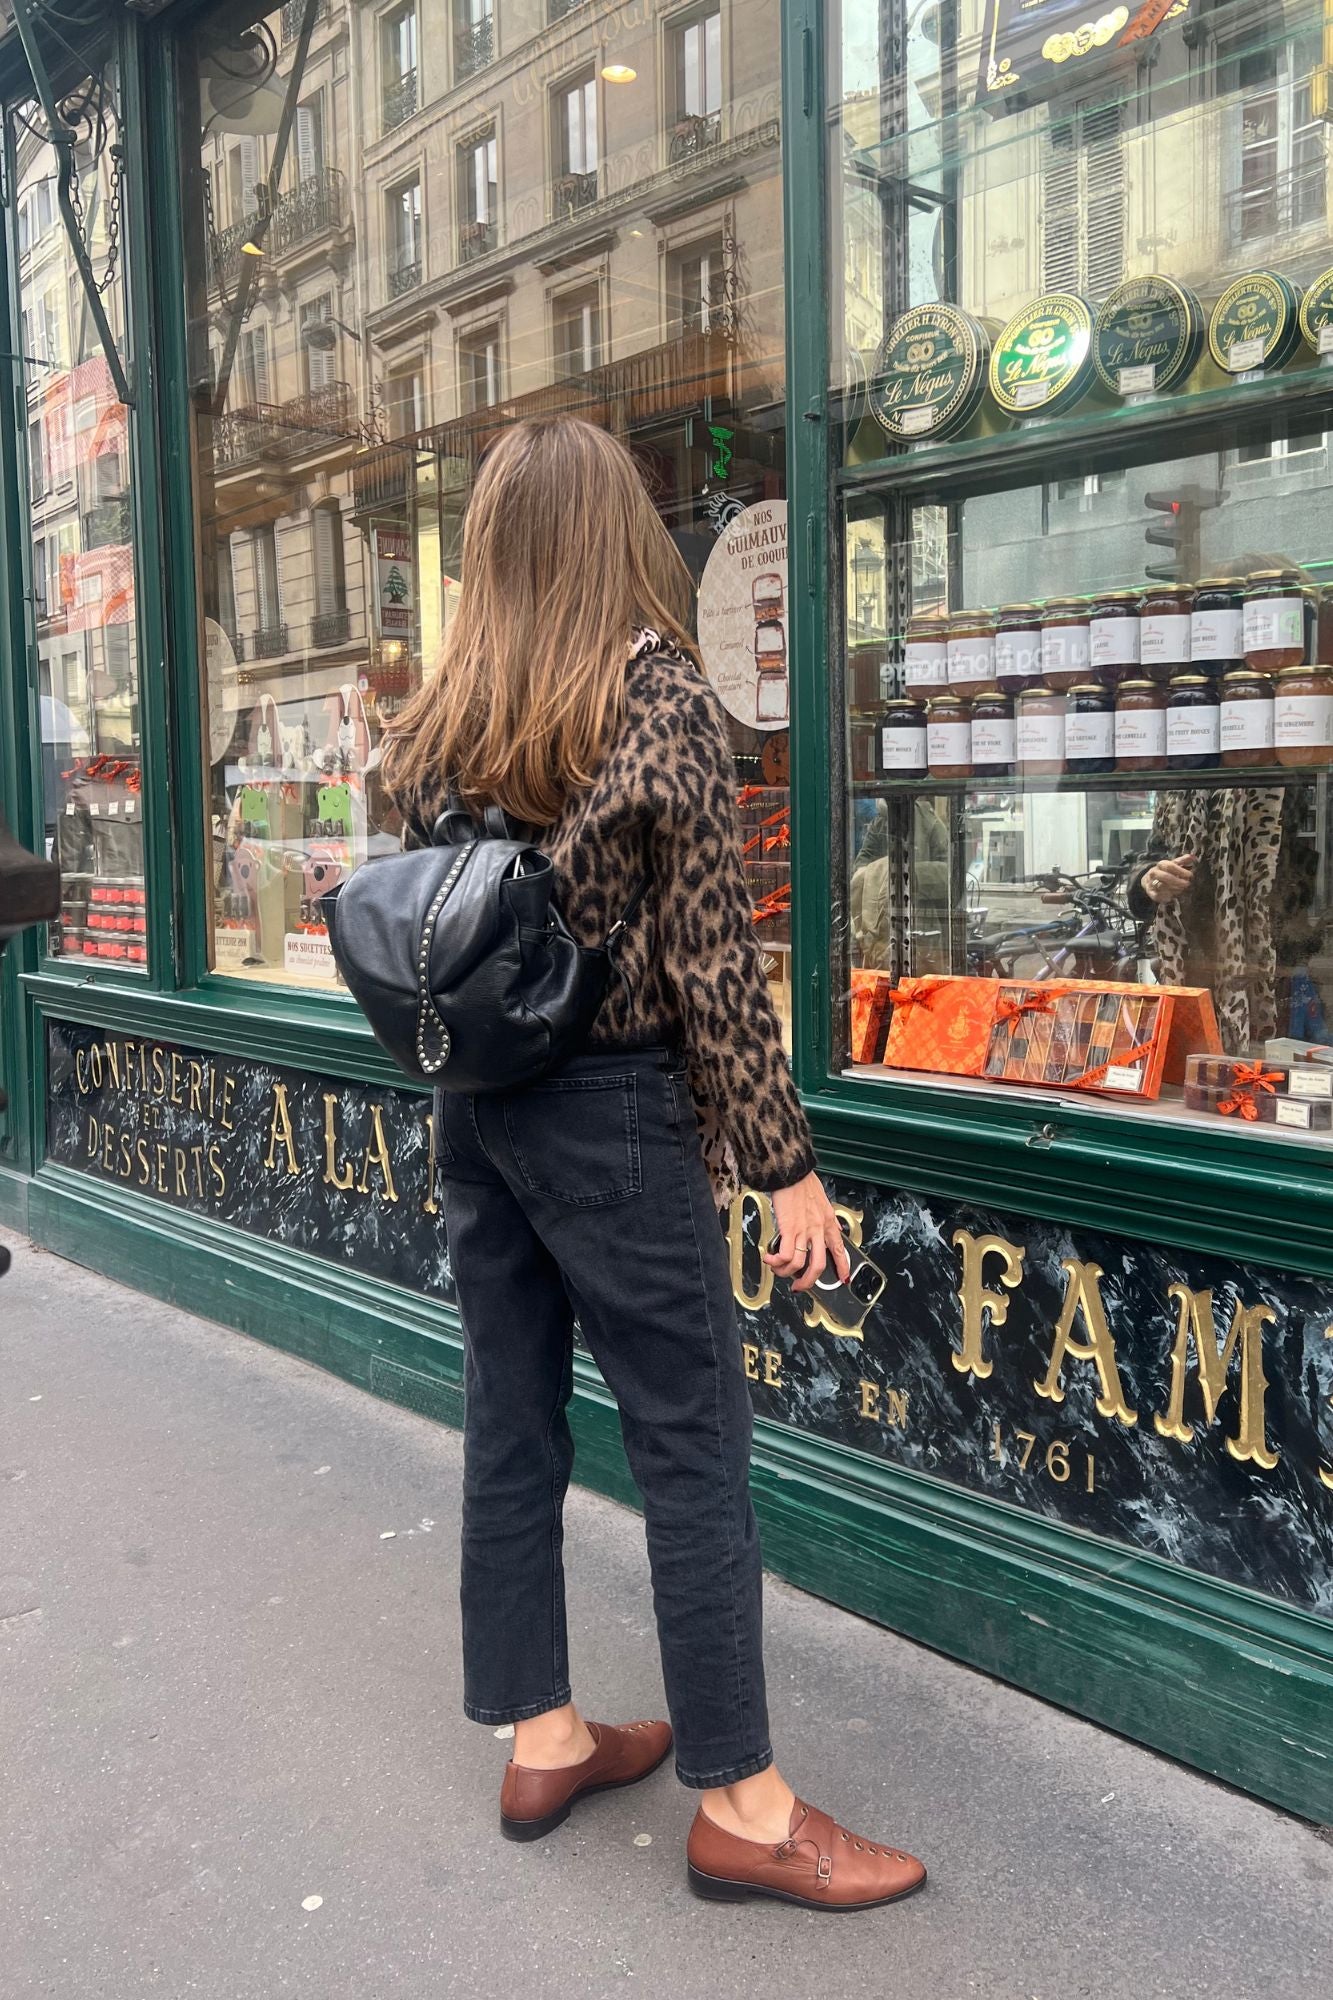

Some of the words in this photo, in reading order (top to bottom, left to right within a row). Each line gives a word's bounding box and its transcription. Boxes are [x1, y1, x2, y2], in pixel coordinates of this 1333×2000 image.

[1106, 342, 1124, 367] Le
[883, 378, 904, 408] Le
[903, 369, 955, 404] Négus
[753, 509, 773, 526] NOS
[727, 522, 788, 556] GUIMAUV
[741, 555, 754, 570] DE
[287, 941, 299, 952] NOS
[300, 942, 333, 955] SUCETTES
[76, 1042, 235, 1130] CONFISERIE
[143, 1103, 161, 1130] ET
[87, 1115, 226, 1198] DESSERTS
[263, 1083, 301, 1175] A
[322, 1093, 399, 1202] LA
[951, 1229, 1333, 1490] FAM
[858, 1379, 909, 1429] EN
[990, 1423, 1095, 1494] 1761
